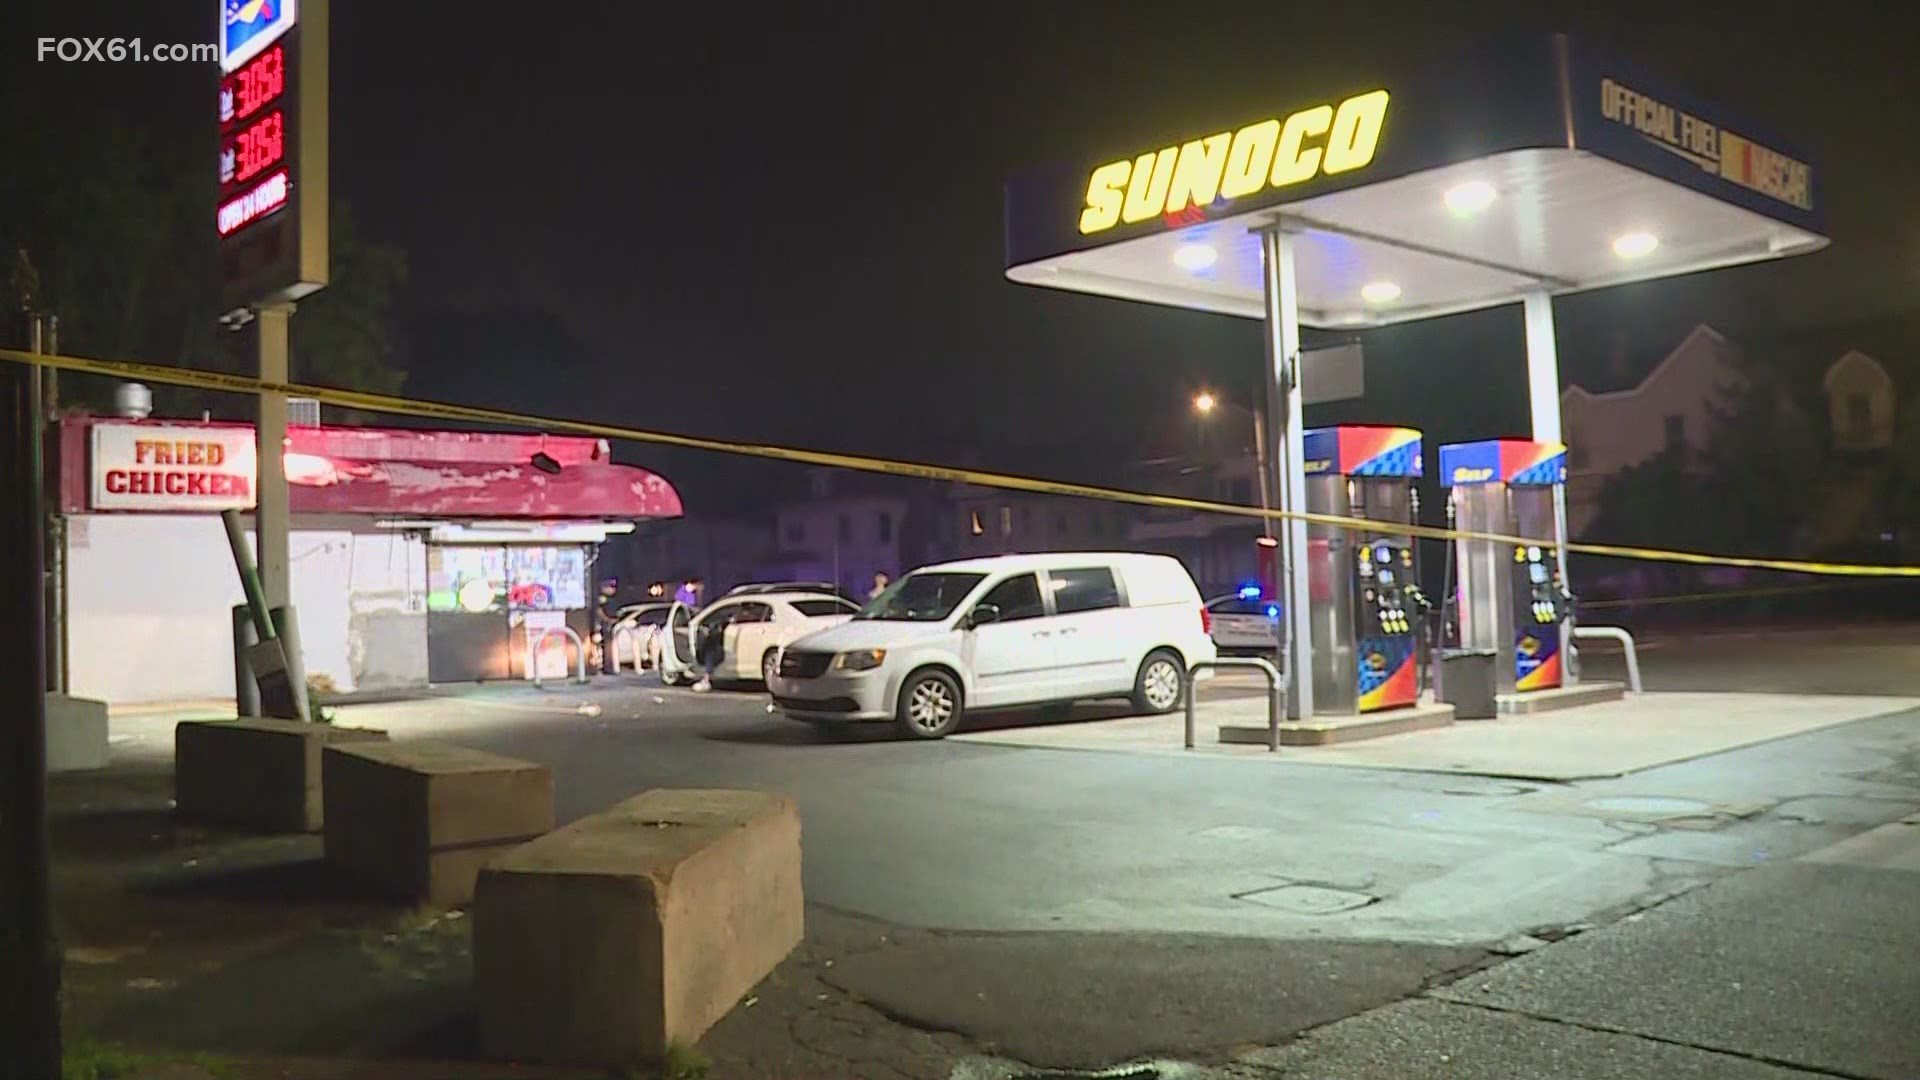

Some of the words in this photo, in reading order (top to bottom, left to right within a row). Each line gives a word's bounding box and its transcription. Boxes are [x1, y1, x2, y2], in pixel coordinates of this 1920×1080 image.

[1601, 77, 1678, 143] OFFICIAL
[1680, 111, 1721, 162] FUEL
[1079, 89, 1390, 235] SUNOCO
[218, 198, 244, 235] OPEN
[135, 440, 226, 466] FRIED
[105, 470, 250, 496] CHICKEN
